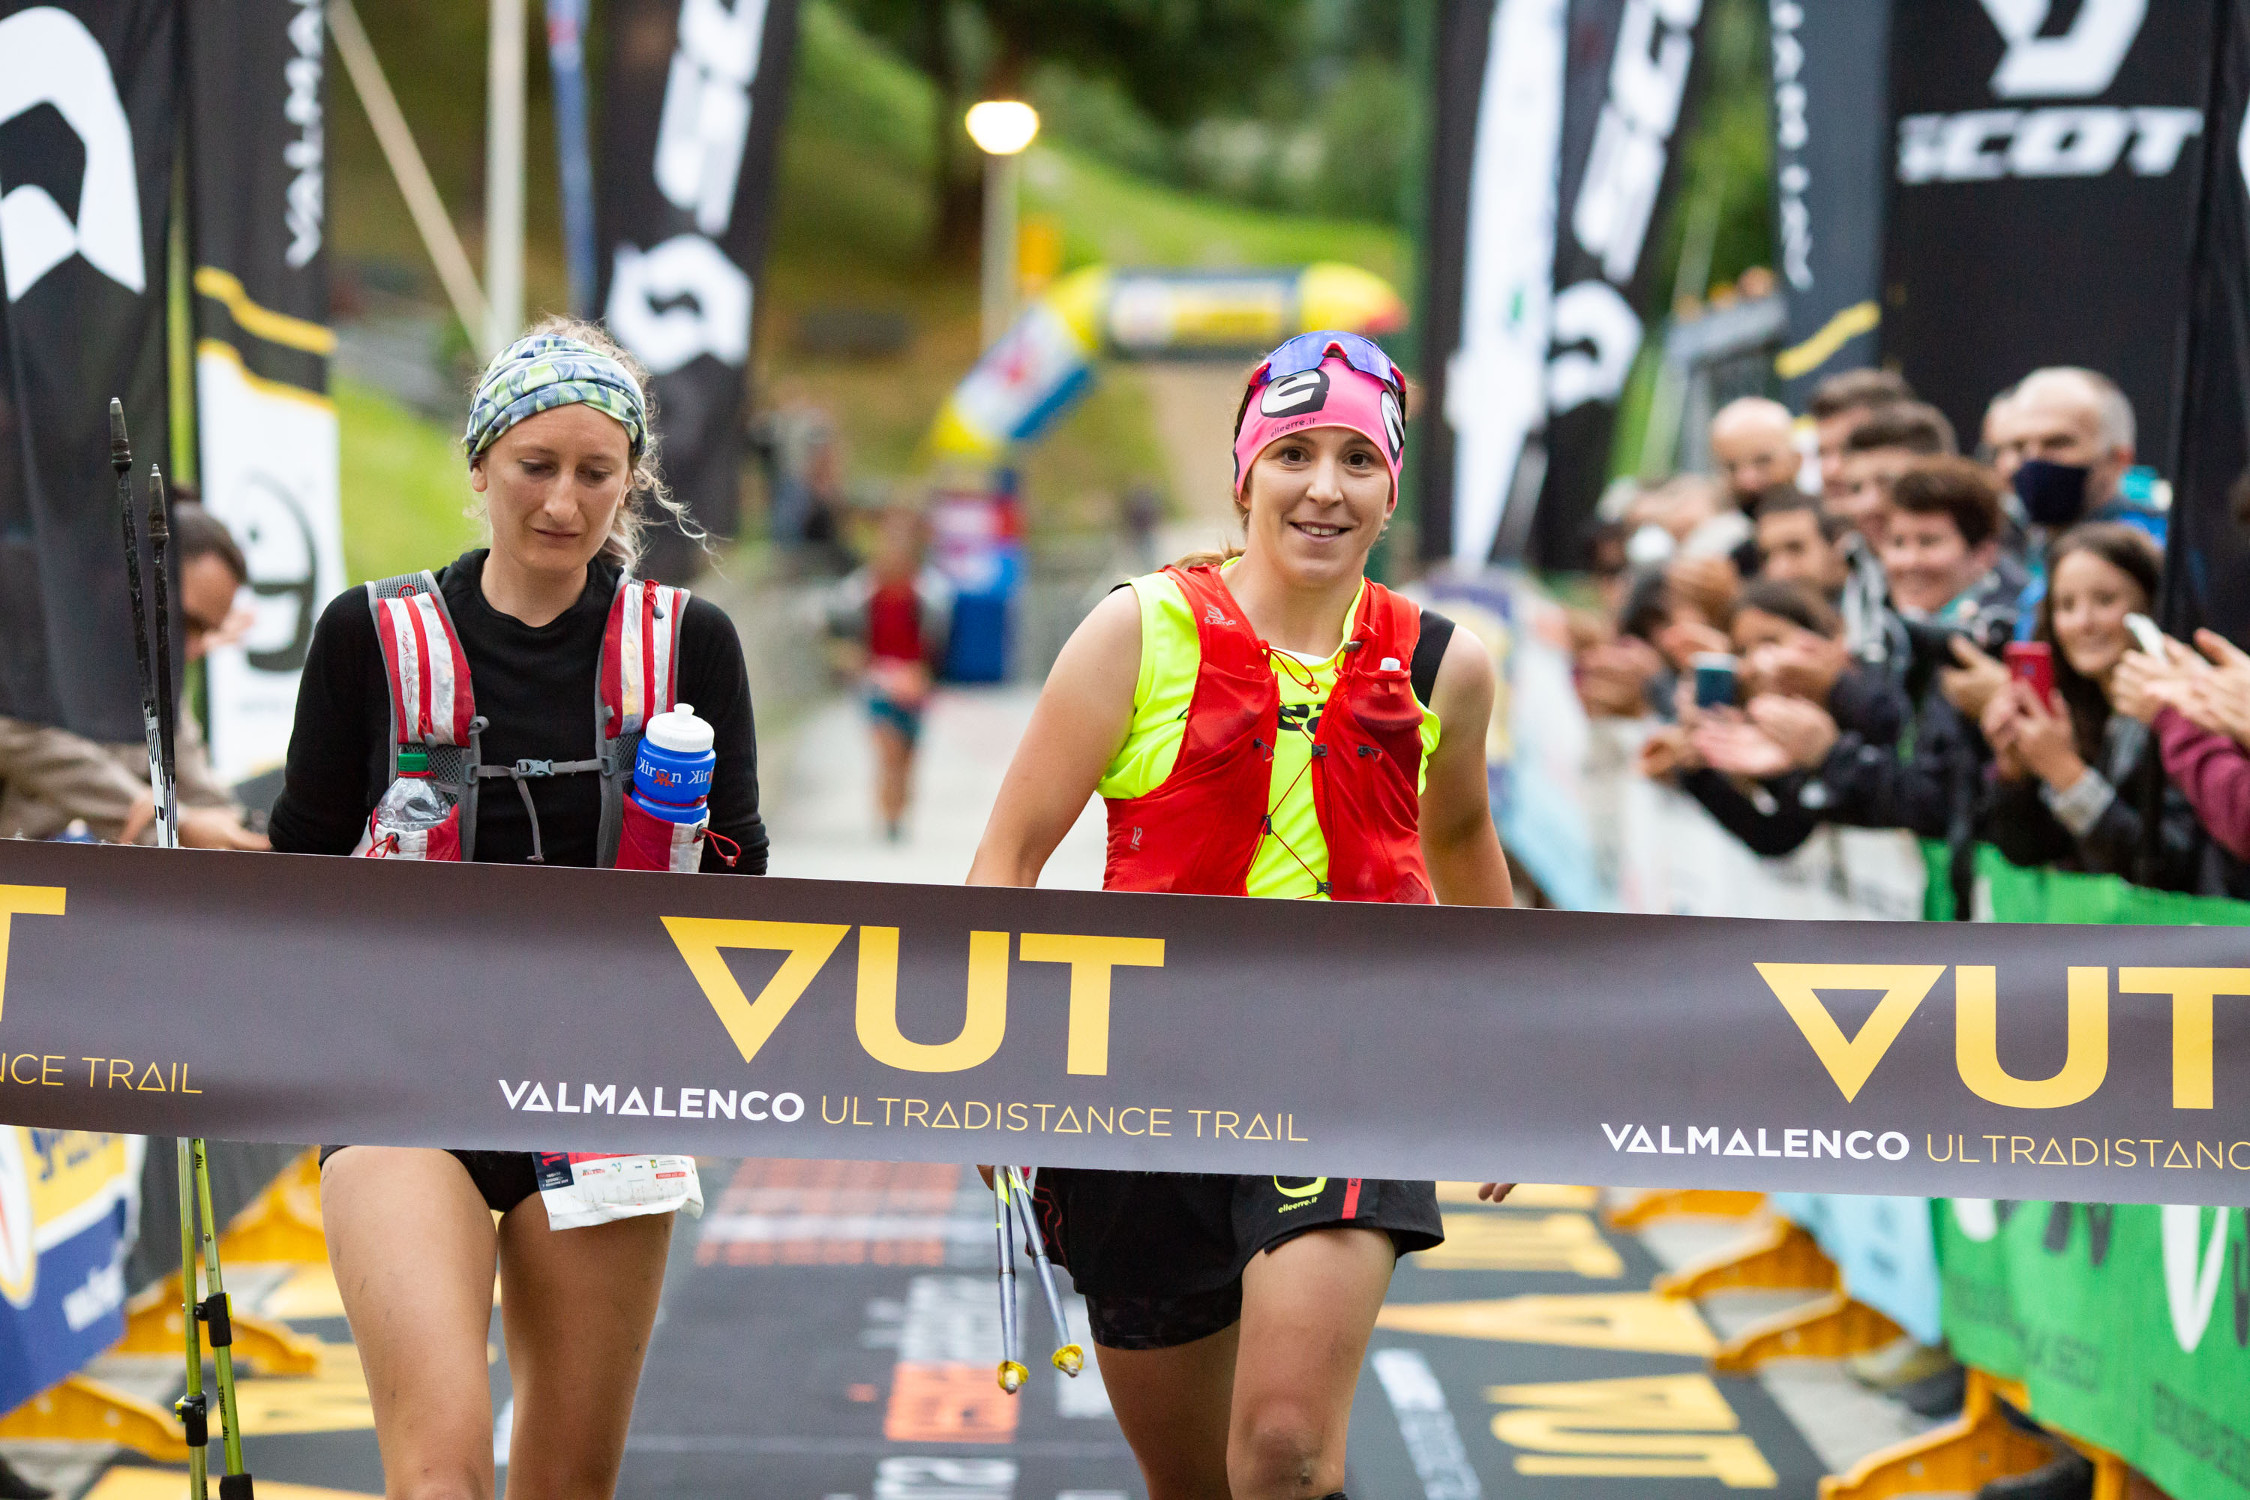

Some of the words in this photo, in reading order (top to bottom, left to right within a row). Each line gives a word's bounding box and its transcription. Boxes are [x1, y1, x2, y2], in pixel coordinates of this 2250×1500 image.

[283, 0, 324, 269] VALMA
[660, 915, 1166, 1077] VUT
[1753, 961, 2250, 1111] VUT
[0, 1052, 66, 1087] CE
[82, 1056, 203, 1095] TRAIL
[498, 1079, 805, 1123] VALMALENCO
[821, 1095, 1172, 1137] ULTRADISTANCE
[1188, 1109, 1309, 1143] TRAIL
[1600, 1123, 1910, 1161] VALMALENCO
[1926, 1132, 2250, 1171] ULTRADISTANC
